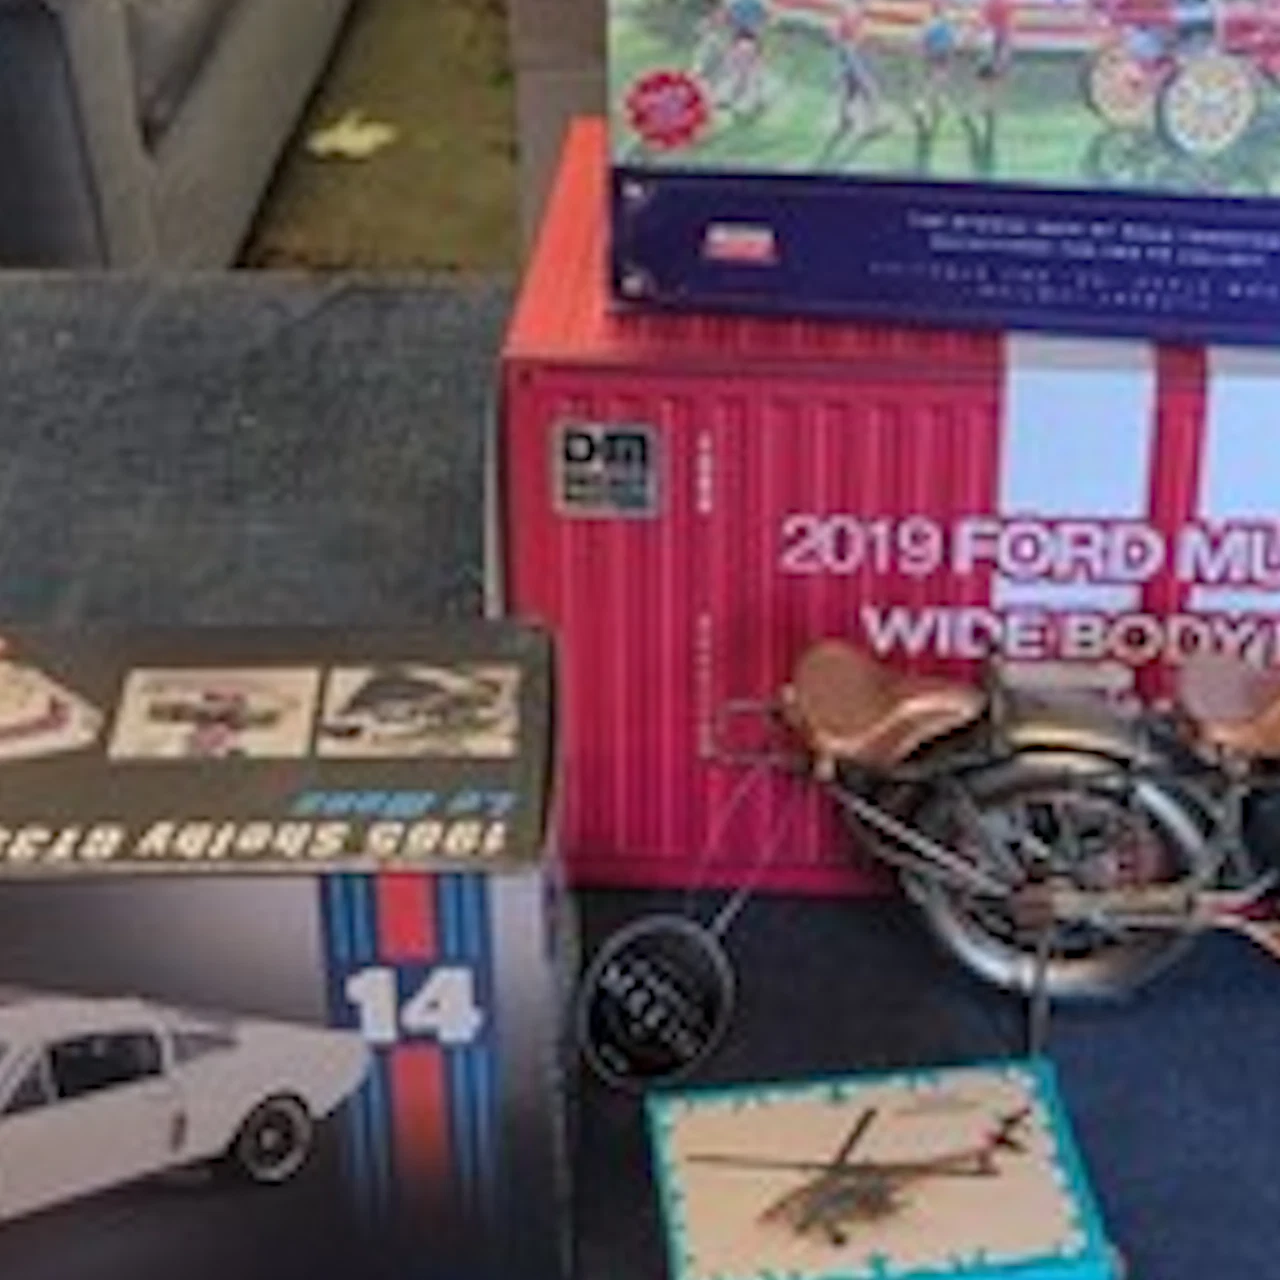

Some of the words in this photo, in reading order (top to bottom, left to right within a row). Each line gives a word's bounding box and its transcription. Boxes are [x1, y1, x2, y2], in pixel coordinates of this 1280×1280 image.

[780, 516, 942, 576] 2019
[955, 520, 1164, 584] FORD
[863, 608, 1042, 658] WIDE
[1063, 613, 1253, 665] BODY
[140, 824, 347, 862] Shelby
[362, 823, 506, 856] 1965
[344, 967, 482, 1042] 14
